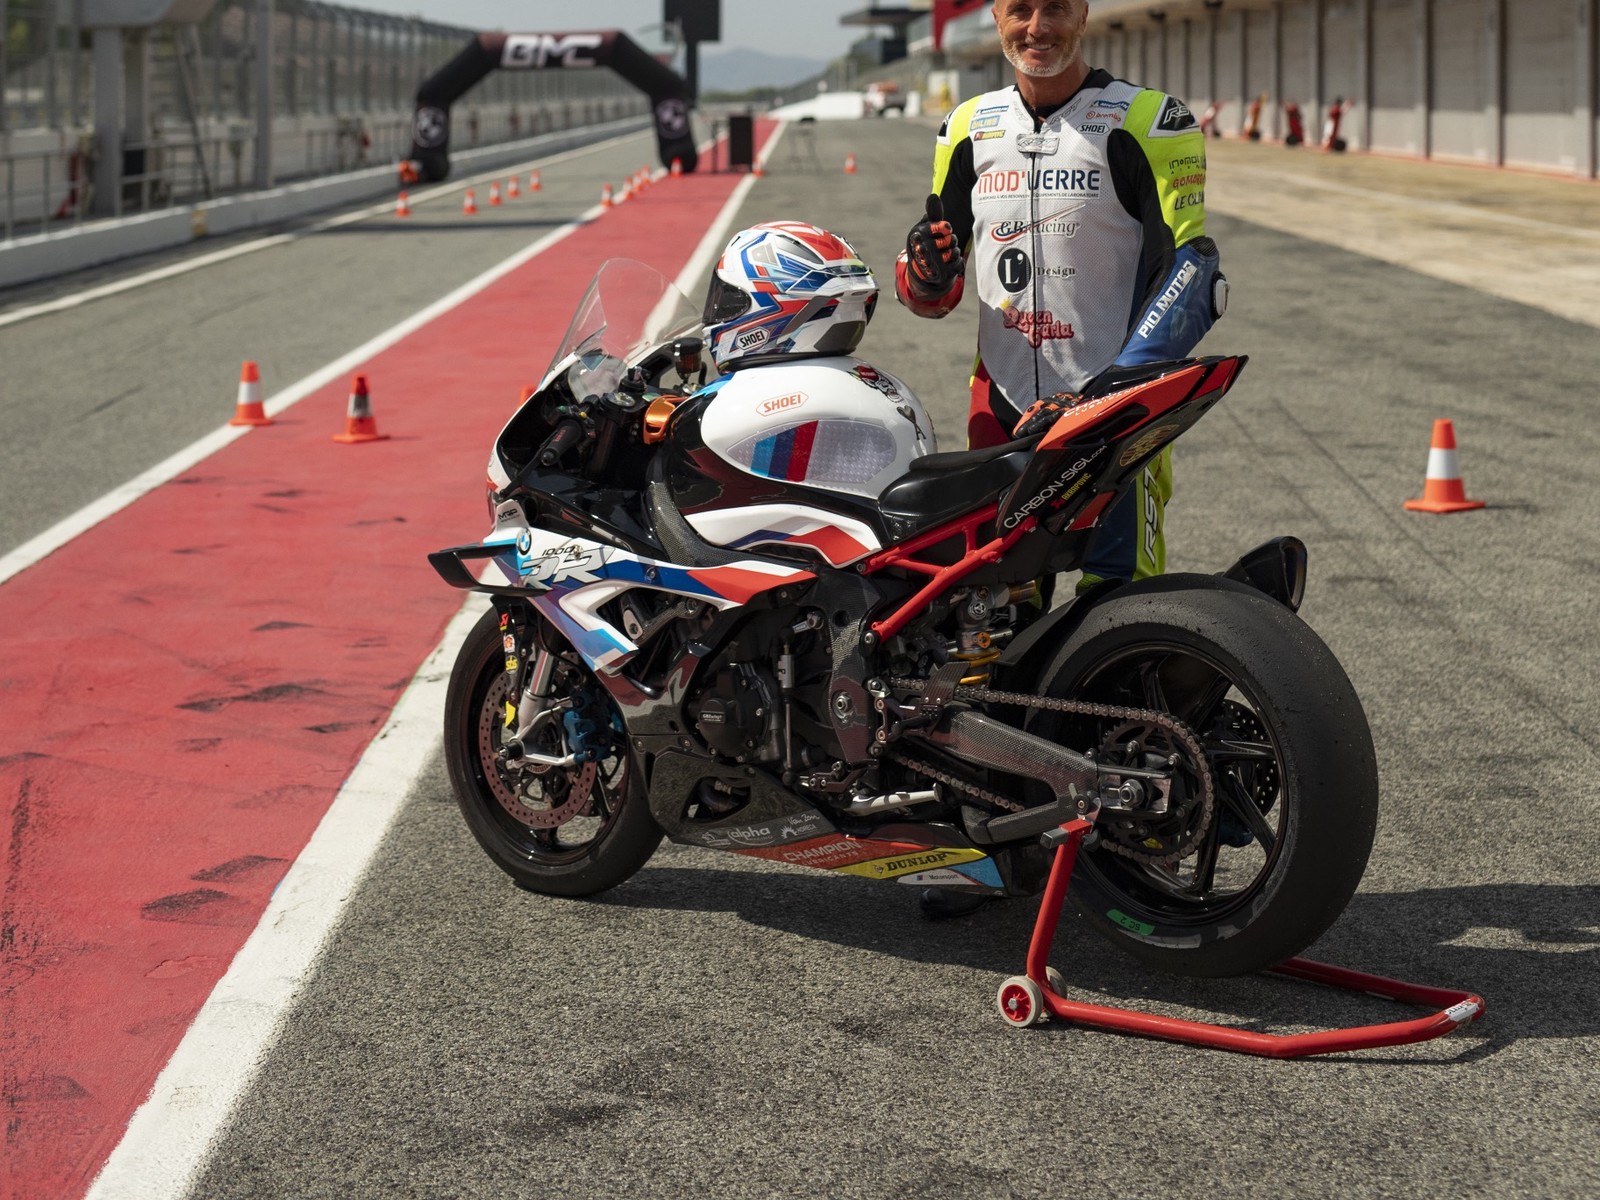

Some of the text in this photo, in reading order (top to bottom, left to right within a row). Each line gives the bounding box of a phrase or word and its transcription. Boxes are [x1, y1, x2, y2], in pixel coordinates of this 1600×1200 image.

[1080, 123, 1107, 134] SHOEI
[1036, 266, 1075, 277] Design
[739, 330, 766, 348] SHOEI
[763, 394, 802, 413] SHOEI
[1003, 445, 1108, 529] CARBON-SIGL.COM
[730, 826, 771, 841] alpha
[783, 840, 862, 862] CHAMPION
[885, 852, 948, 871] DUNLOP
